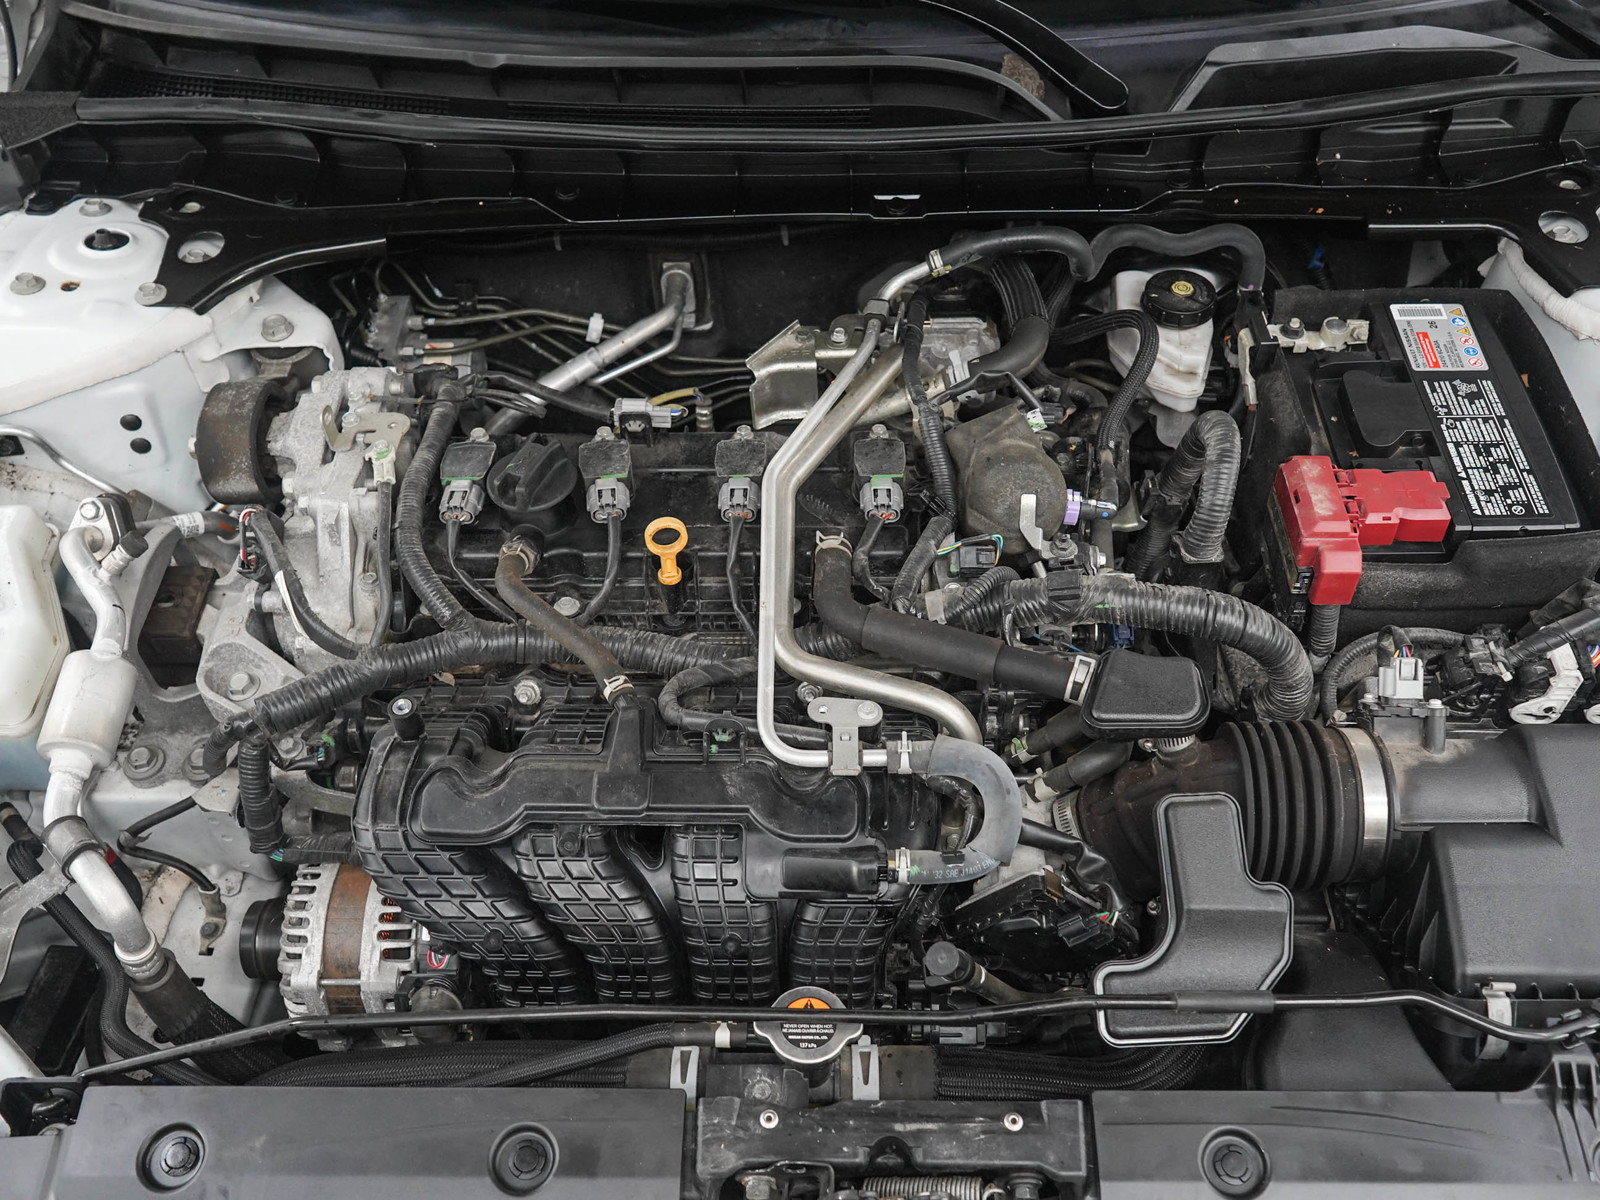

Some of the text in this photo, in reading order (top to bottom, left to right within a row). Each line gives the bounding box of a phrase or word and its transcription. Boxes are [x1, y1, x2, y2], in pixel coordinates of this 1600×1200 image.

[1427, 320, 1438, 328] 26
[1401, 328, 1413, 347] NISSAN
[945, 869, 959, 878] SAE
